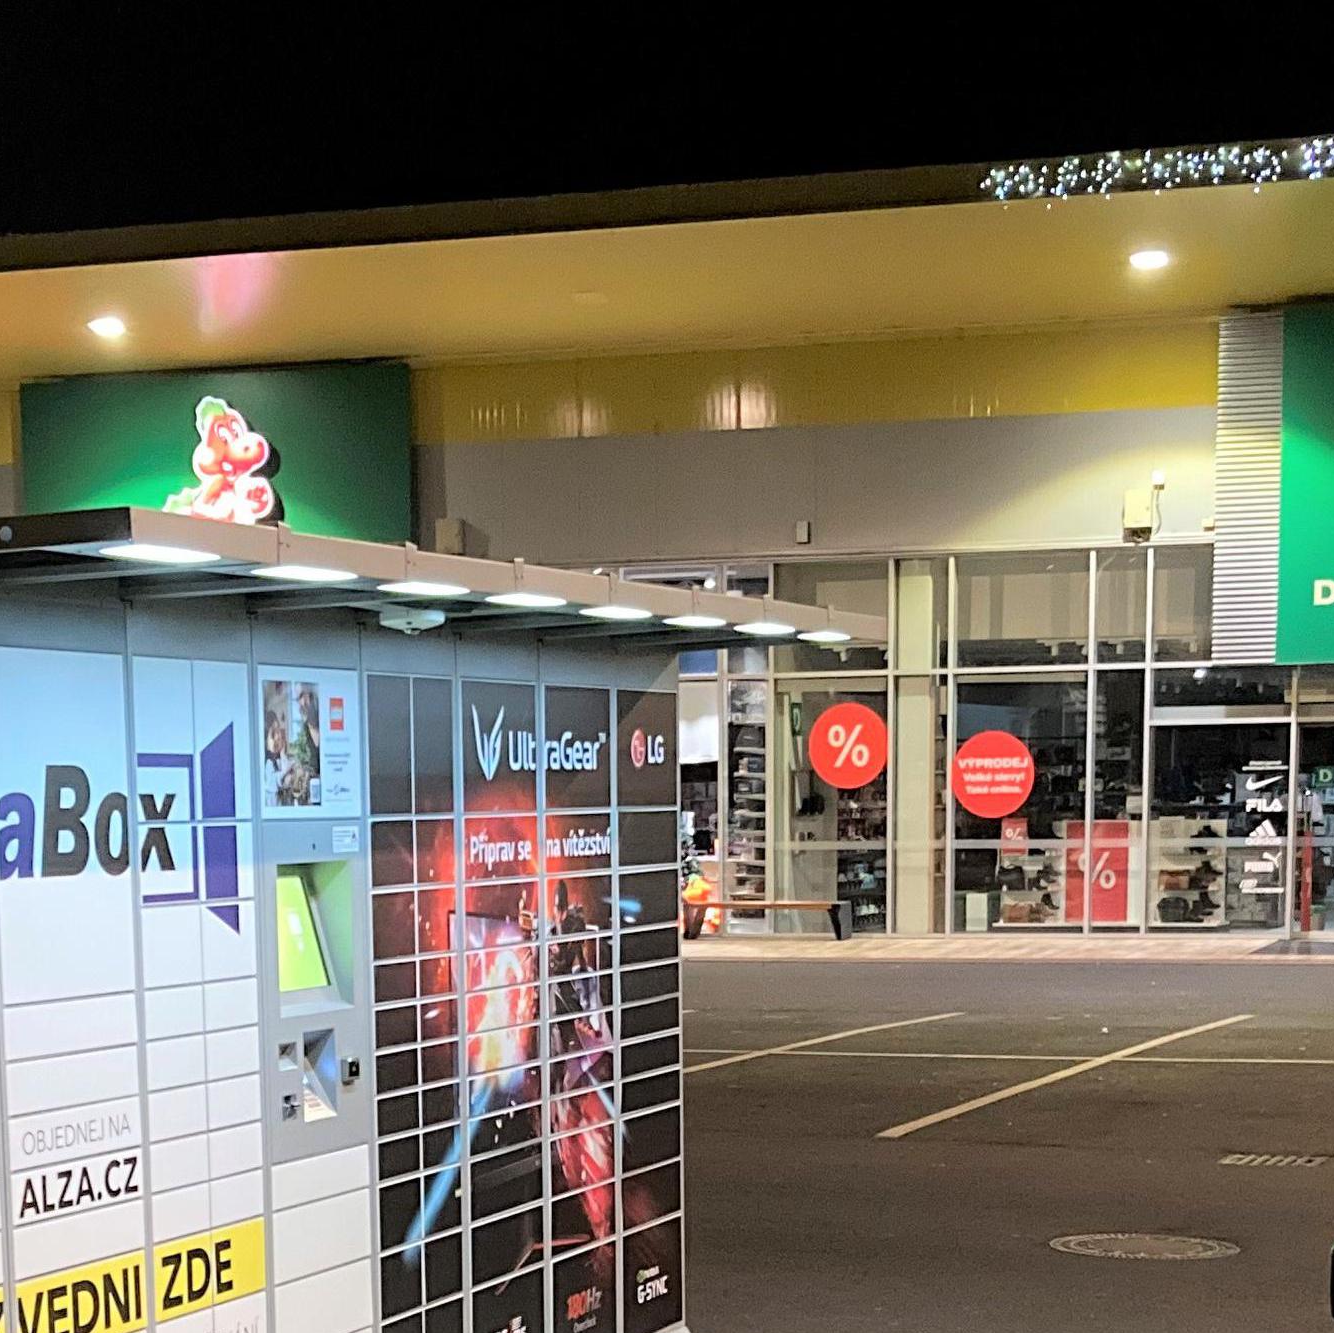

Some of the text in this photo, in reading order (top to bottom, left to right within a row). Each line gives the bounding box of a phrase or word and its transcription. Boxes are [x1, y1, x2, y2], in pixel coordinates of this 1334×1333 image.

[646, 735, 665, 765] LG
[827, 724, 870, 768] %
[469, 831, 515, 871] Připrav
[517, 843, 532, 860] se
[546, 839, 561, 858] na
[21, 1113, 133, 1156] OBJEDNEJ NA
[18, 1156, 139, 1219] ALZA.CZ
[161, 1239, 234, 1310] ZDE
